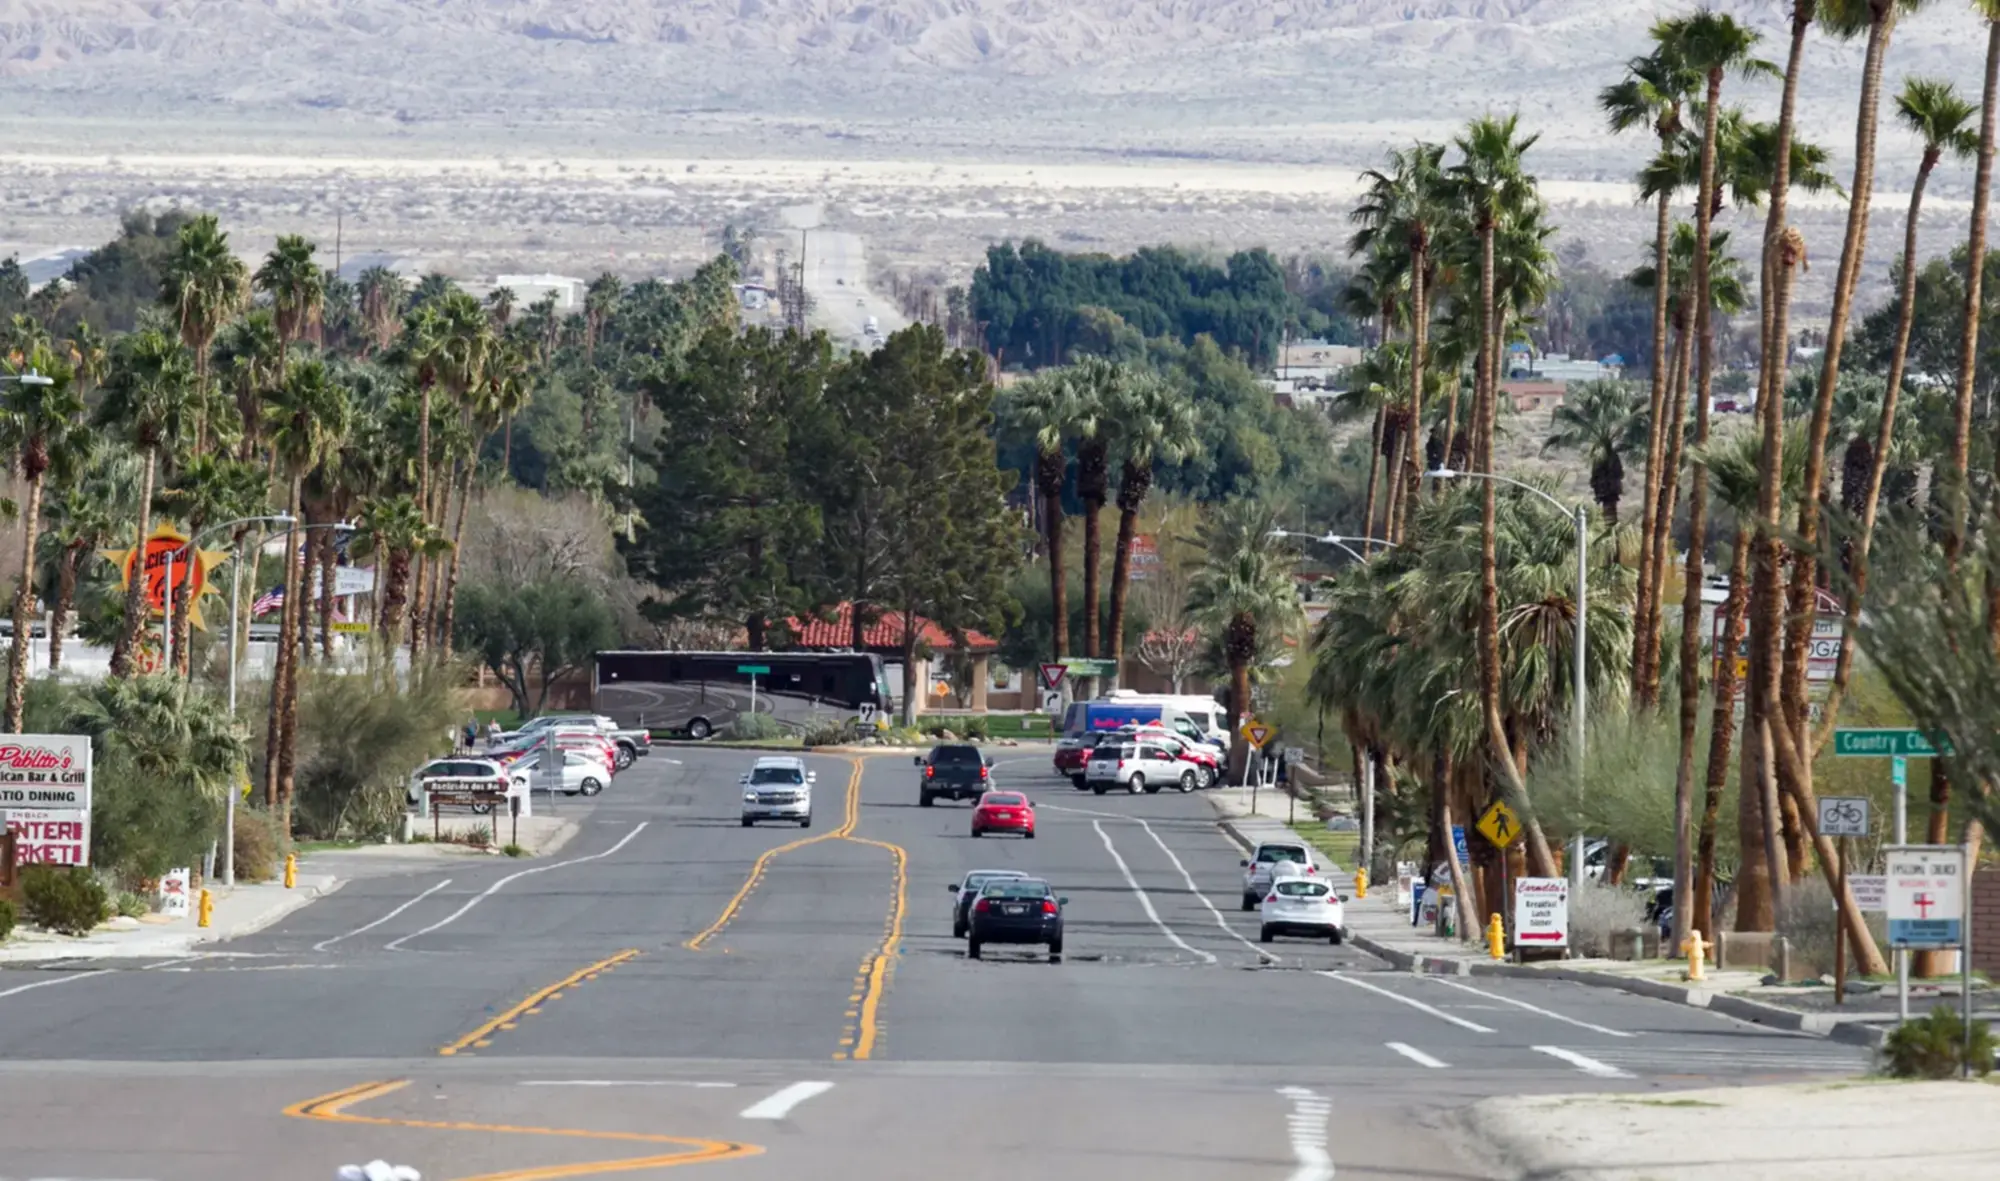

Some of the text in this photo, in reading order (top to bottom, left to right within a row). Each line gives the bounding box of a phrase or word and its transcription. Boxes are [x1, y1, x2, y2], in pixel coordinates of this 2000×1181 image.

[1843, 732, 1898, 753] Country
[1906, 732, 1937, 750] Clu
[0, 746, 72, 769] Pablito's
[28, 772, 46, 782] Bar
[51, 772, 57, 782] &
[61, 771, 85, 783] Grill
[0, 790, 75, 802] TIO DINING
[16, 844, 71, 863] RKET
